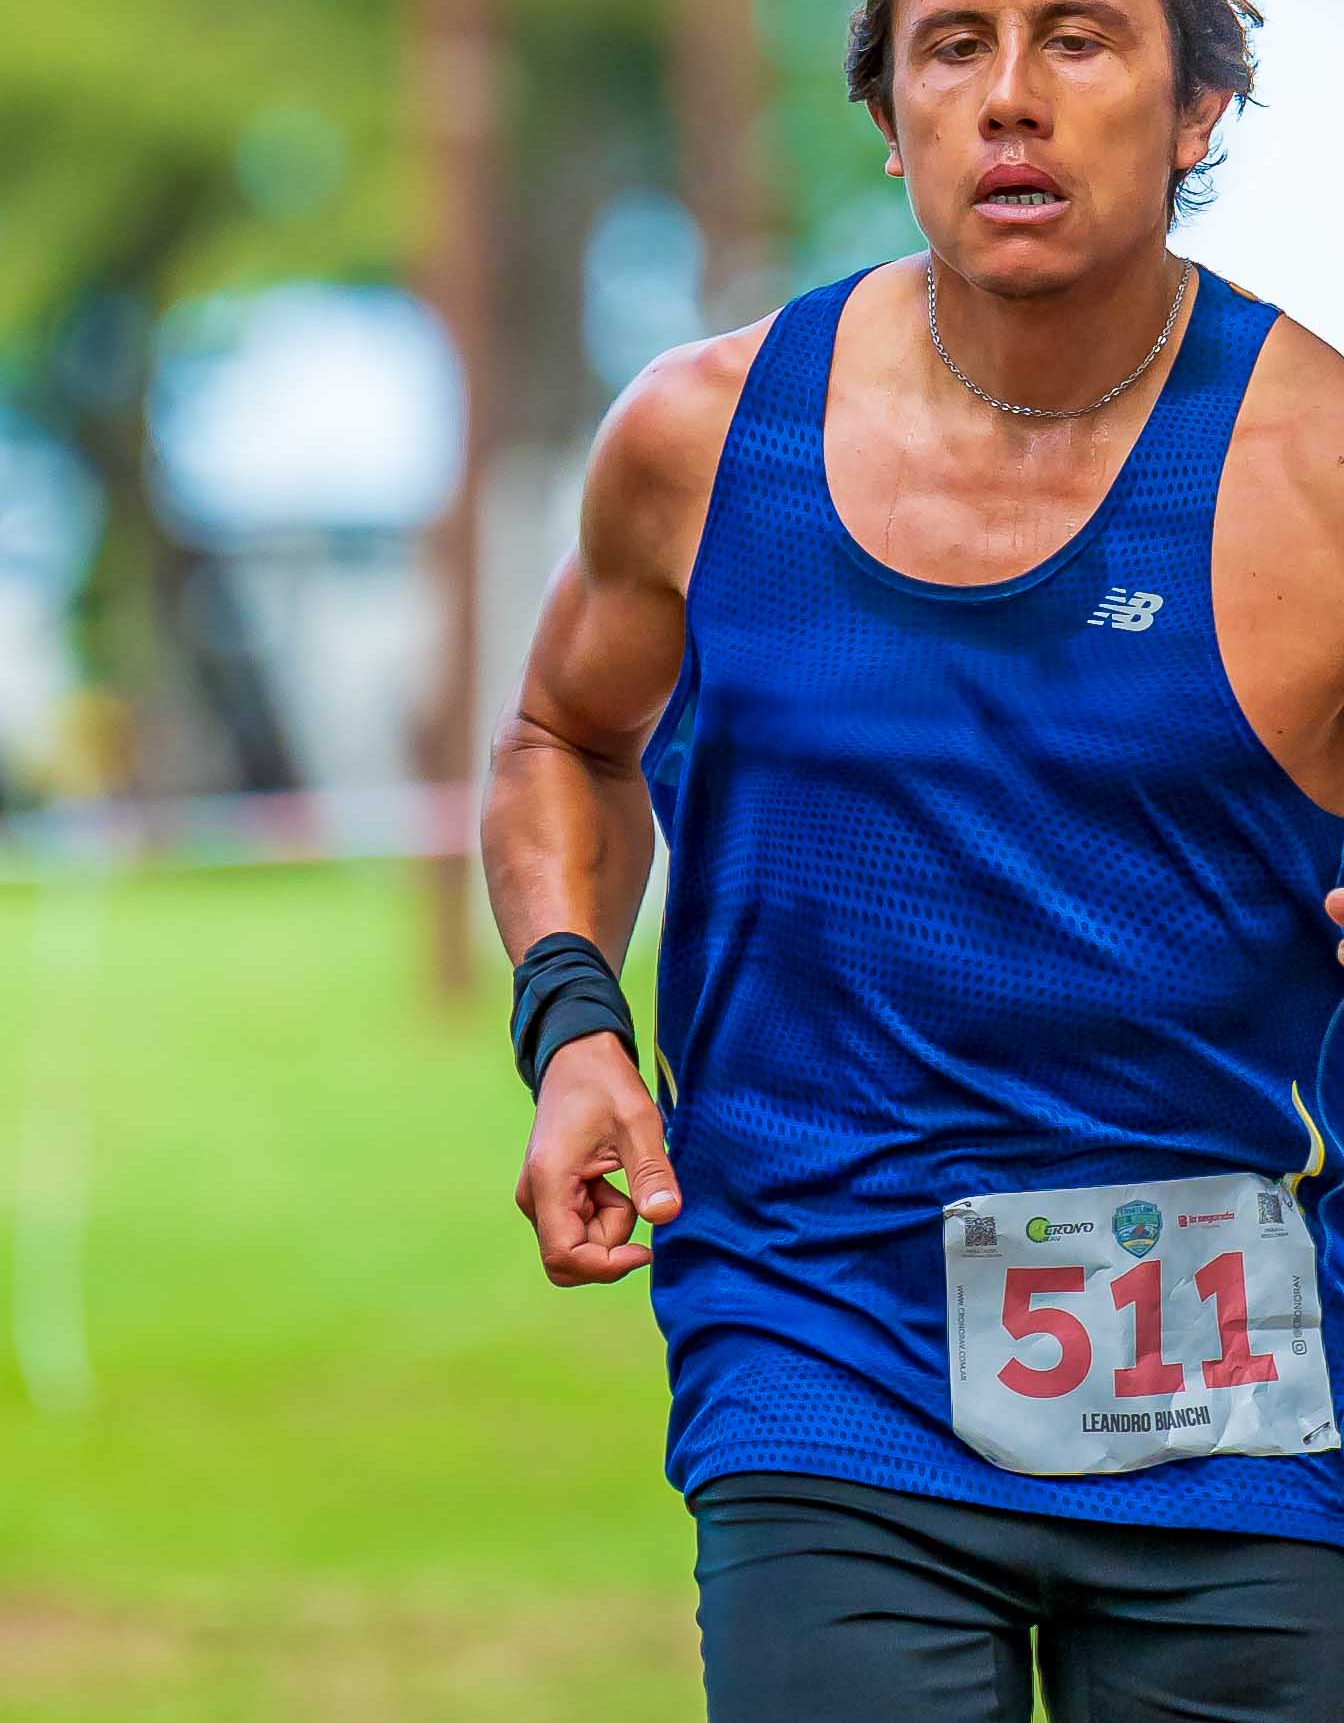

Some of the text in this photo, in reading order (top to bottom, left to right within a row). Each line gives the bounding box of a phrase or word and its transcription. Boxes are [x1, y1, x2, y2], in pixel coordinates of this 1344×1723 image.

[996, 1251, 1280, 1399] 511
[1082, 1406, 1212, 1433] LEANDRO BIANCHI
